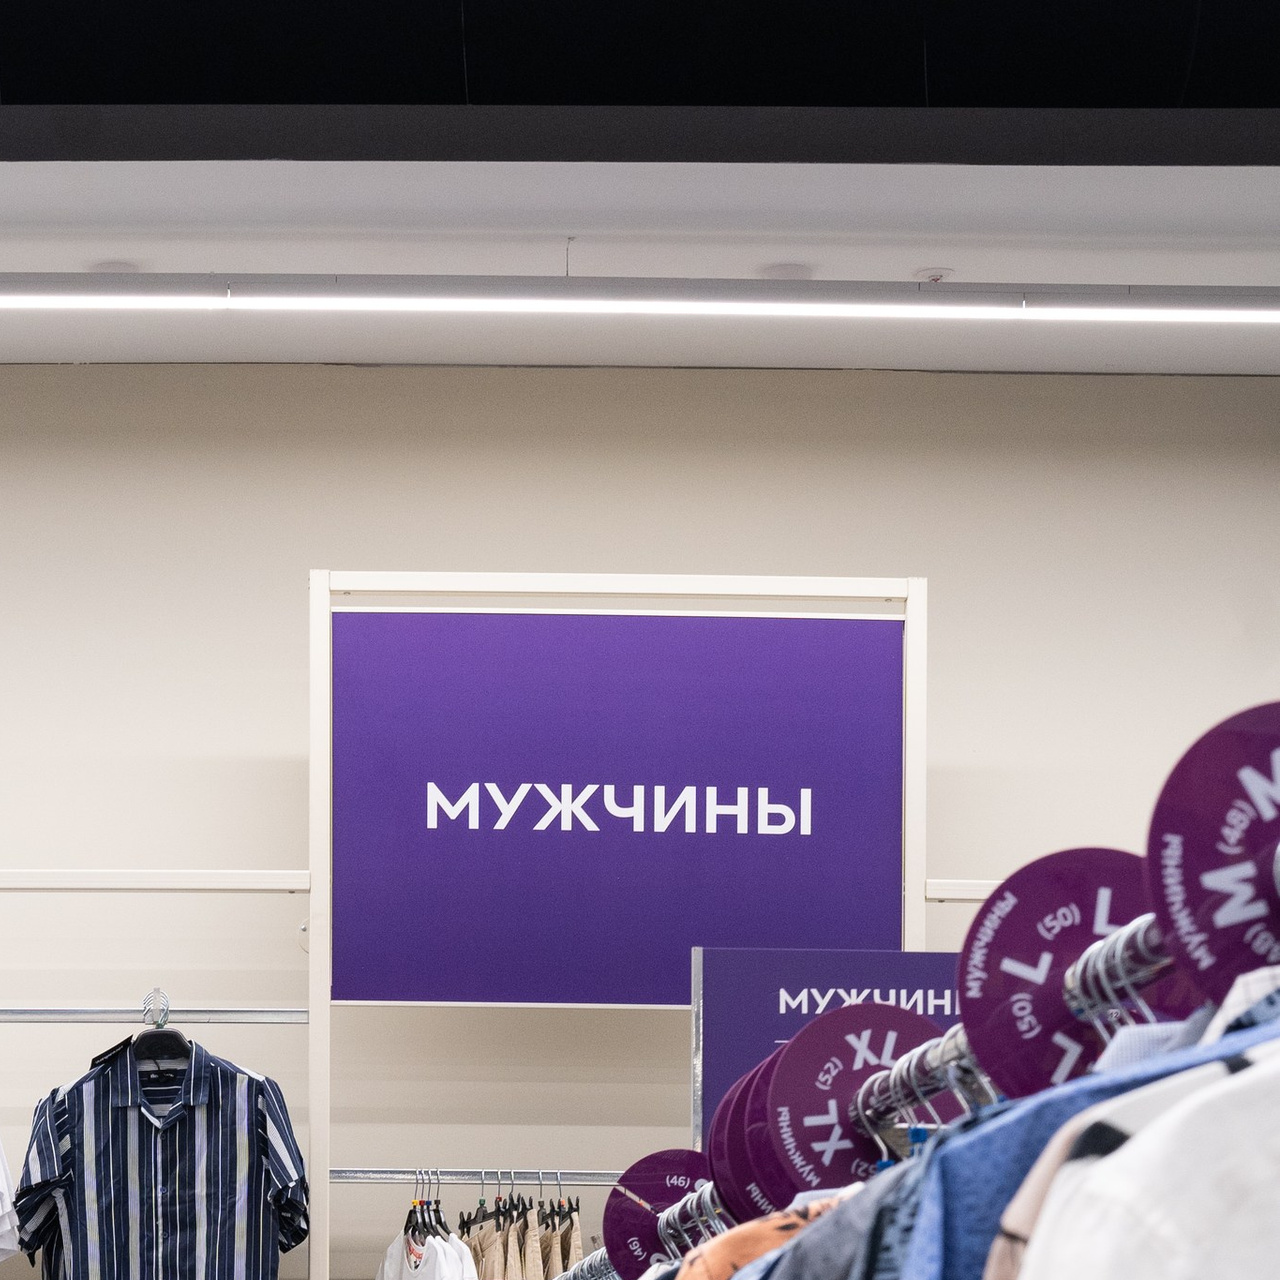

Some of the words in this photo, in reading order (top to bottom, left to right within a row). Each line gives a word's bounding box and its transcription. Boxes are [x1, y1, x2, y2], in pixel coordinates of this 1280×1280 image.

[426, 781, 812, 835] МУЖЧИНЫ
[1199, 860, 1269, 929] M
[1037, 903, 1081, 940] (50)
[1000, 951, 1054, 985] L
[779, 988, 960, 1015] МУЖЧИН
[1011, 993, 1042, 1039] (50)
[844, 1029, 900, 1071] XL
[815, 1056, 844, 1091] (52)
[803, 1098, 854, 1167] XL
[665, 1175, 691, 1189] (46)
[626, 1237, 647, 1261] (46)
